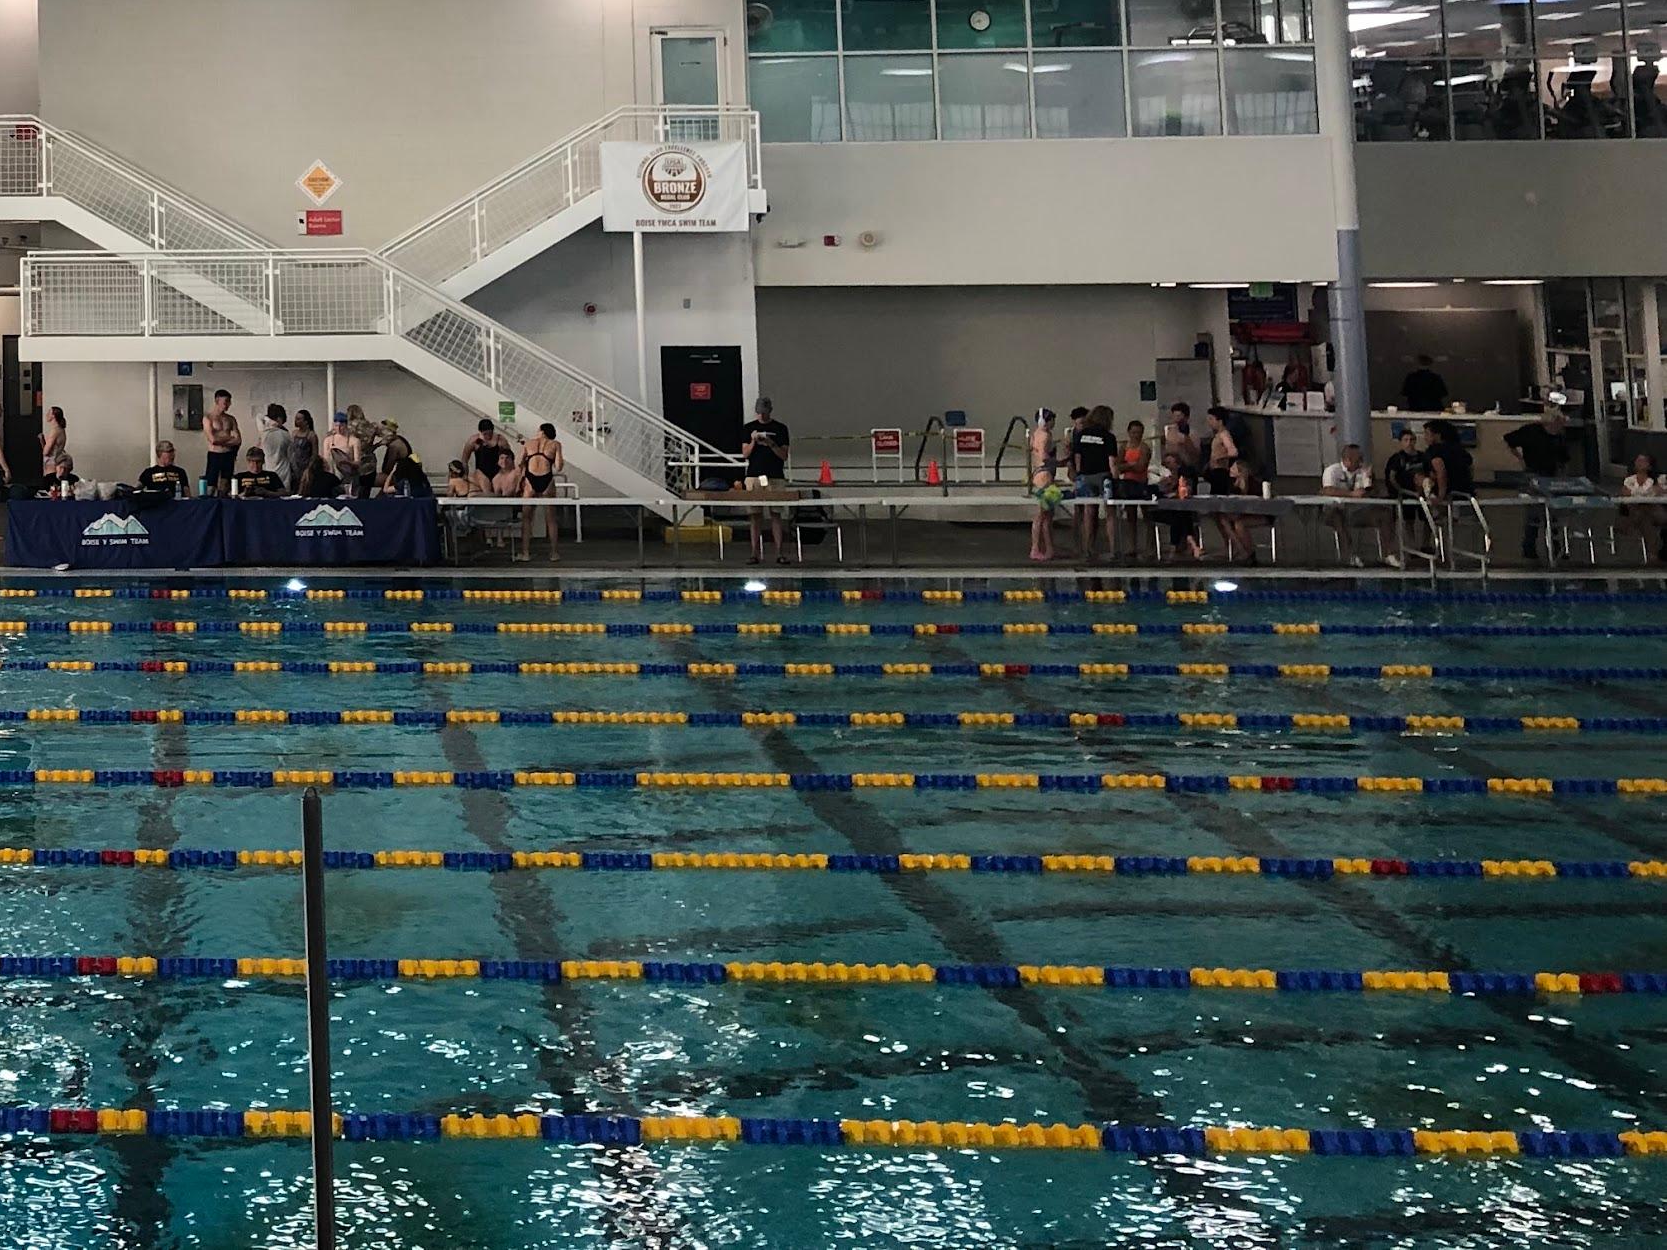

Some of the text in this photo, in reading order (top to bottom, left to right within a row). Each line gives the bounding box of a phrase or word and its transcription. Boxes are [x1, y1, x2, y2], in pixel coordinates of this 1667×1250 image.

[653, 182, 697, 194] BRONZE
[635, 219, 716, 227] BOISE YMCA SWIM TEAM
